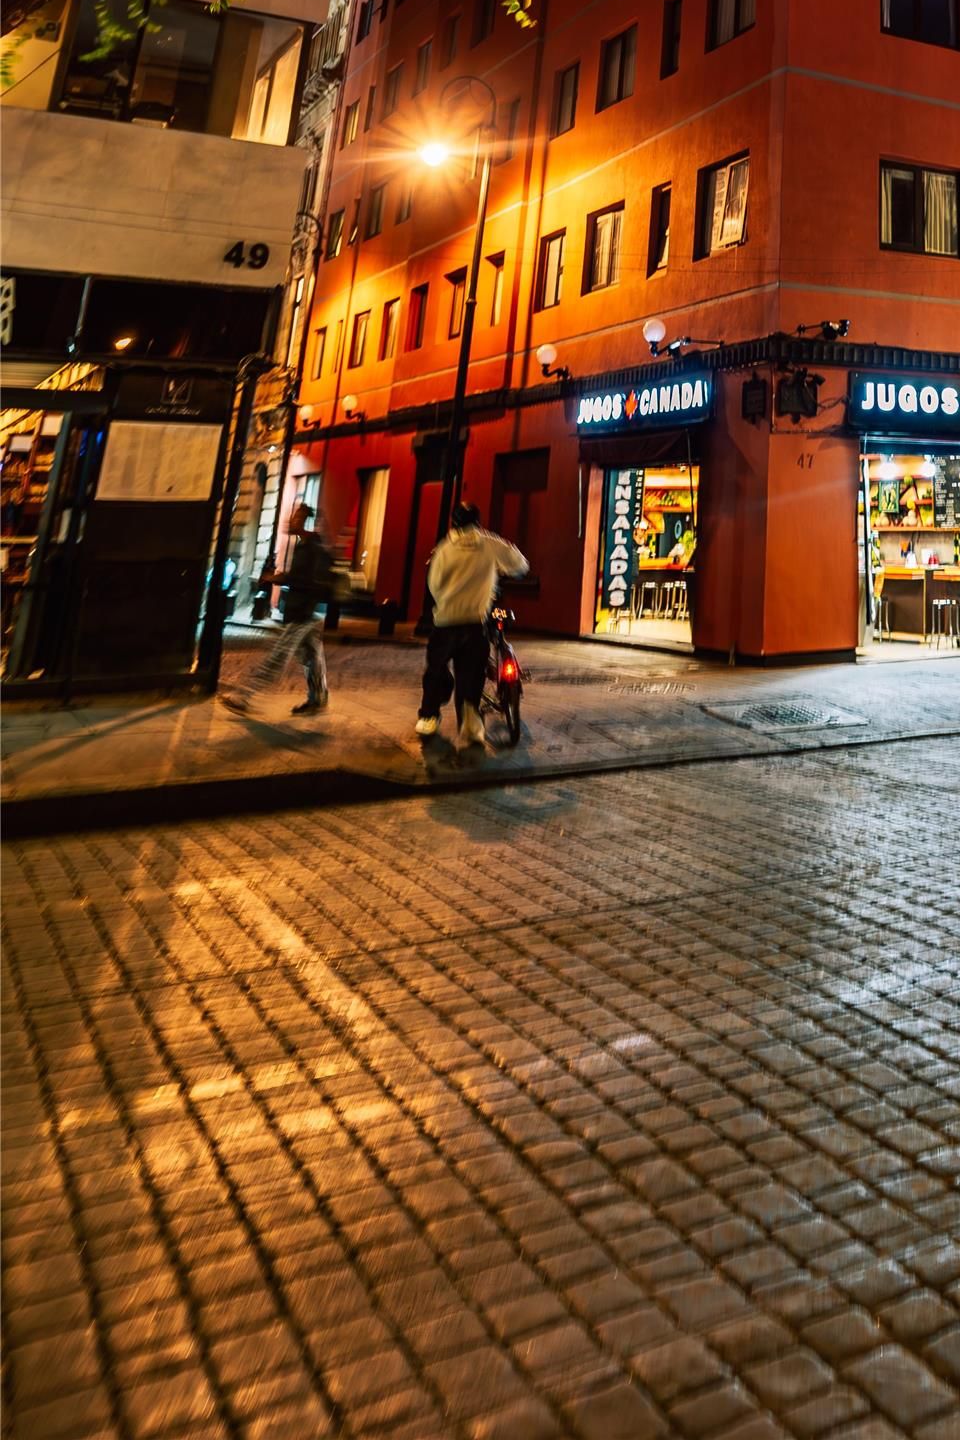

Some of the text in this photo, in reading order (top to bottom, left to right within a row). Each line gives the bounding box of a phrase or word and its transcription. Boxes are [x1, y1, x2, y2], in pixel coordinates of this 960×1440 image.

[223, 241, 269, 269] 49
[577, 379, 703, 424] JUGOS CANADA
[861, 381, 960, 415] JUGOS
[797, 453, 815, 469] 47
[607, 470, 632, 607] ENSALADAS
